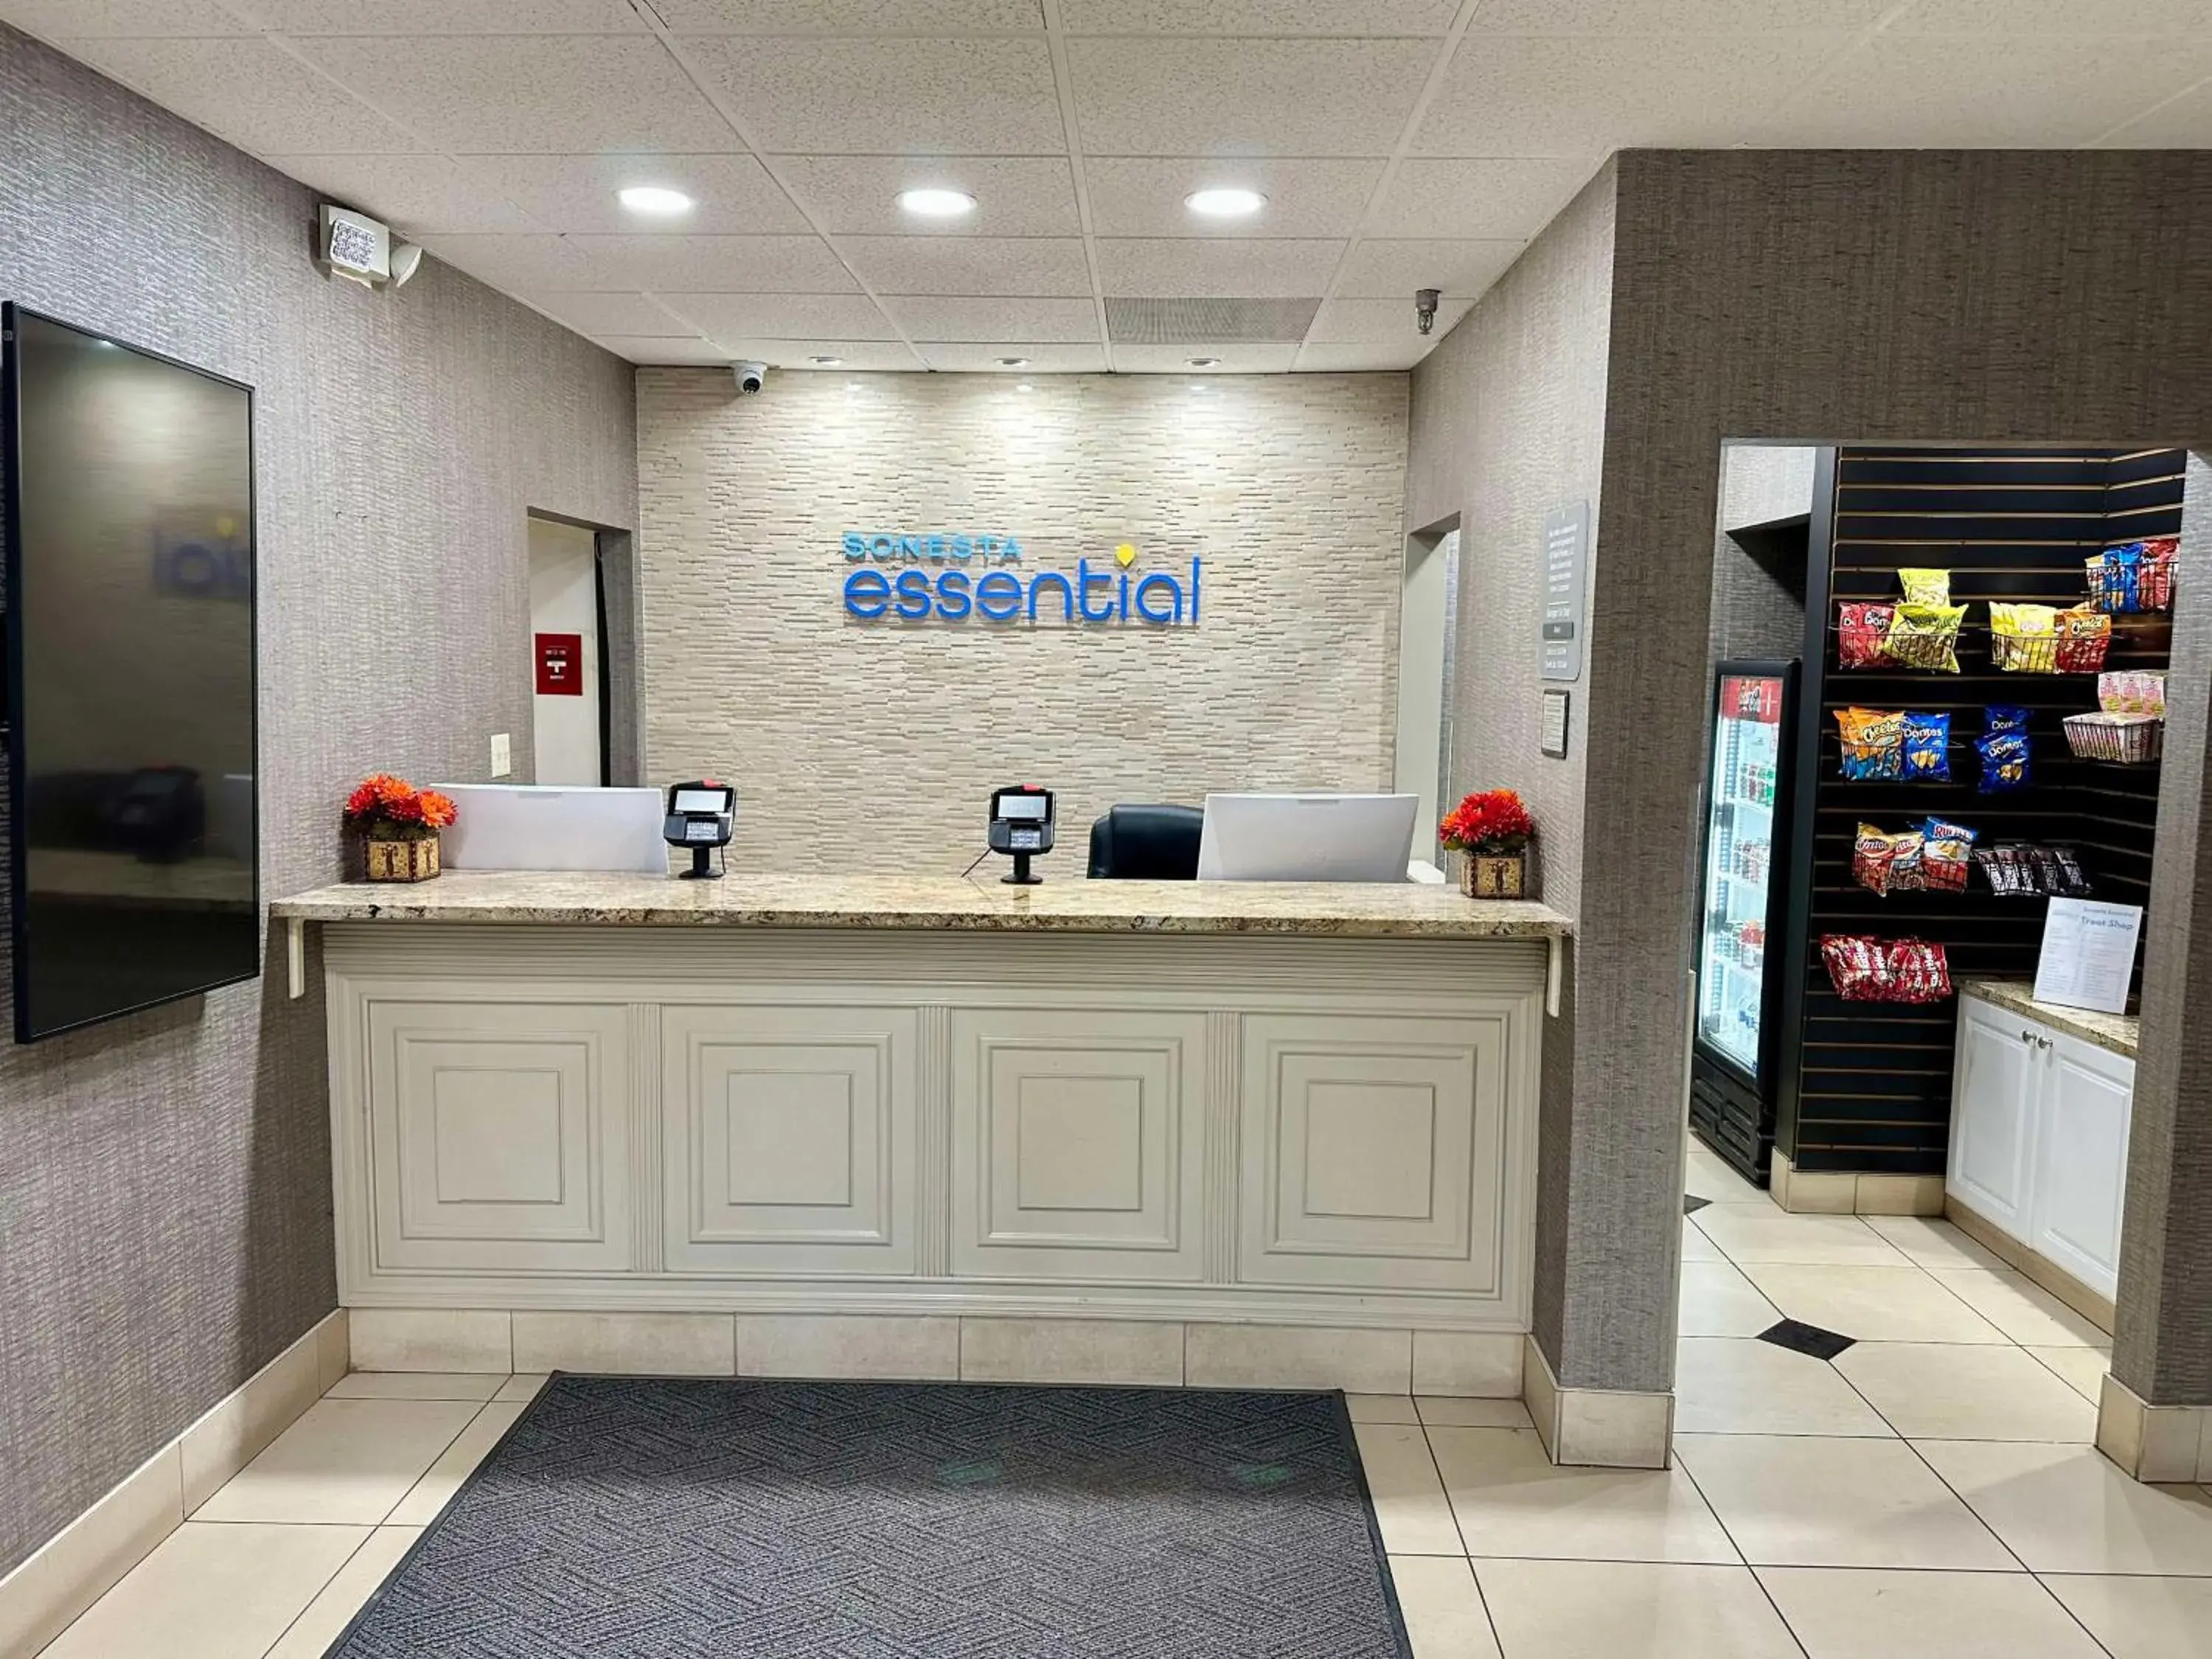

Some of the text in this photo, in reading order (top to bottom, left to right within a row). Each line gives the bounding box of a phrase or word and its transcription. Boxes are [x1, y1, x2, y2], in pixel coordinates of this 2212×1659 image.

[844, 532, 1023, 559] SONESTA
[844, 544, 1200, 625] essential
[1903, 726, 1944, 740] Doritos
